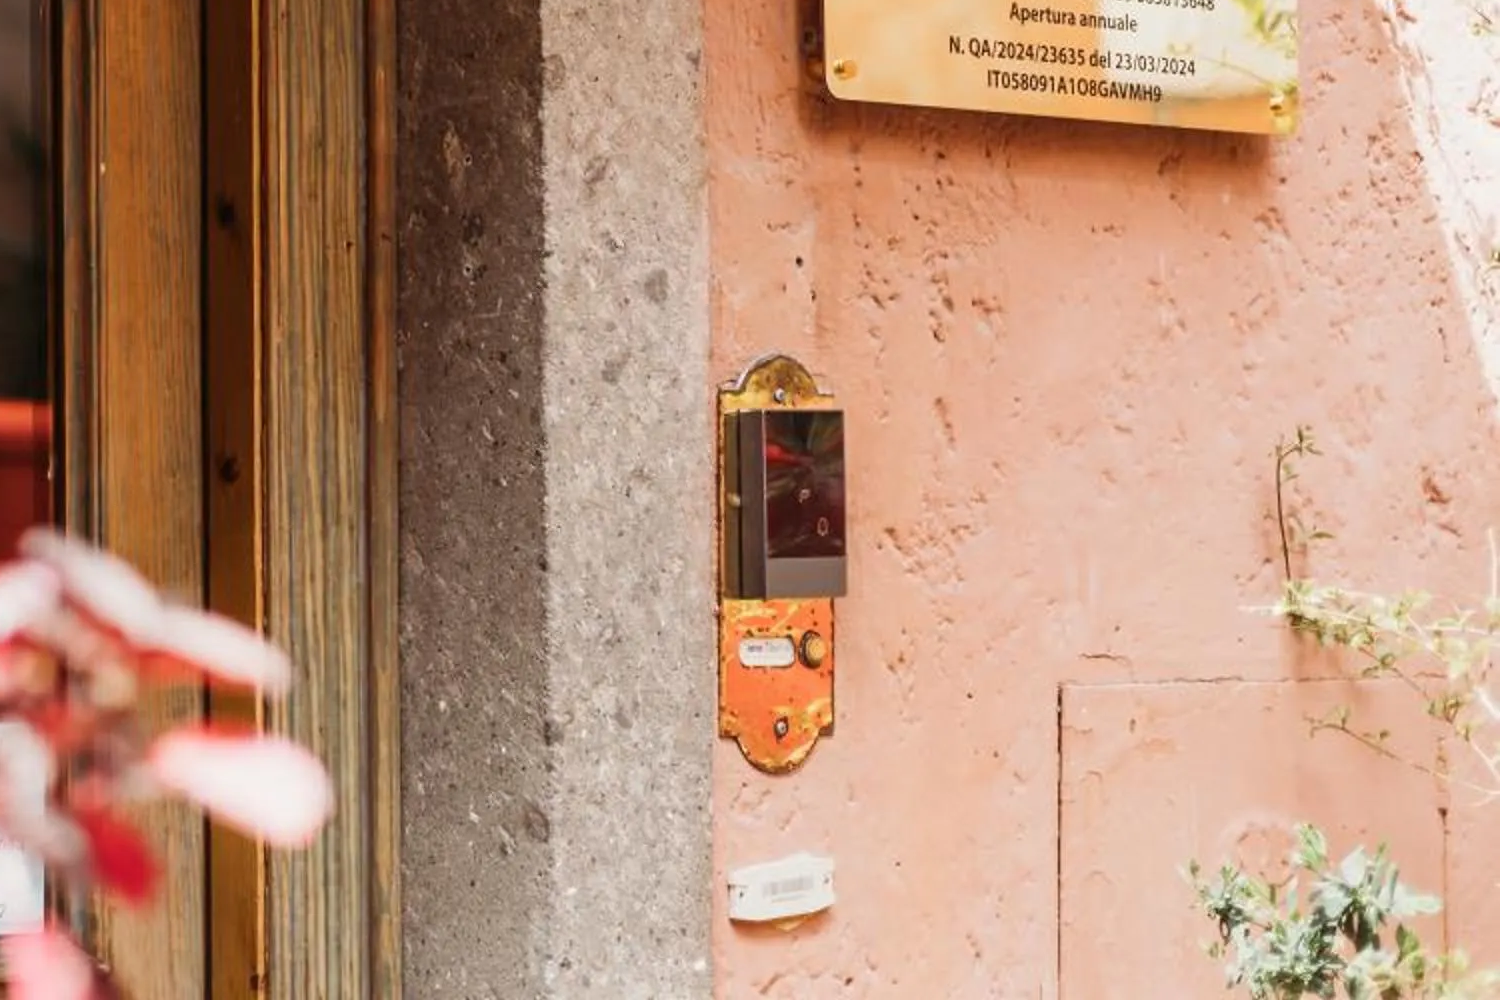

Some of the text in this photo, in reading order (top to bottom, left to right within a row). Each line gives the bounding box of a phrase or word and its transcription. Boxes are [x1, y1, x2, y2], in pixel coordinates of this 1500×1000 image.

[1009, 1, 1138, 33] Apertura annuale
[949, 35, 1197, 77] N. QA/2024/23635 del 23/03/2024
